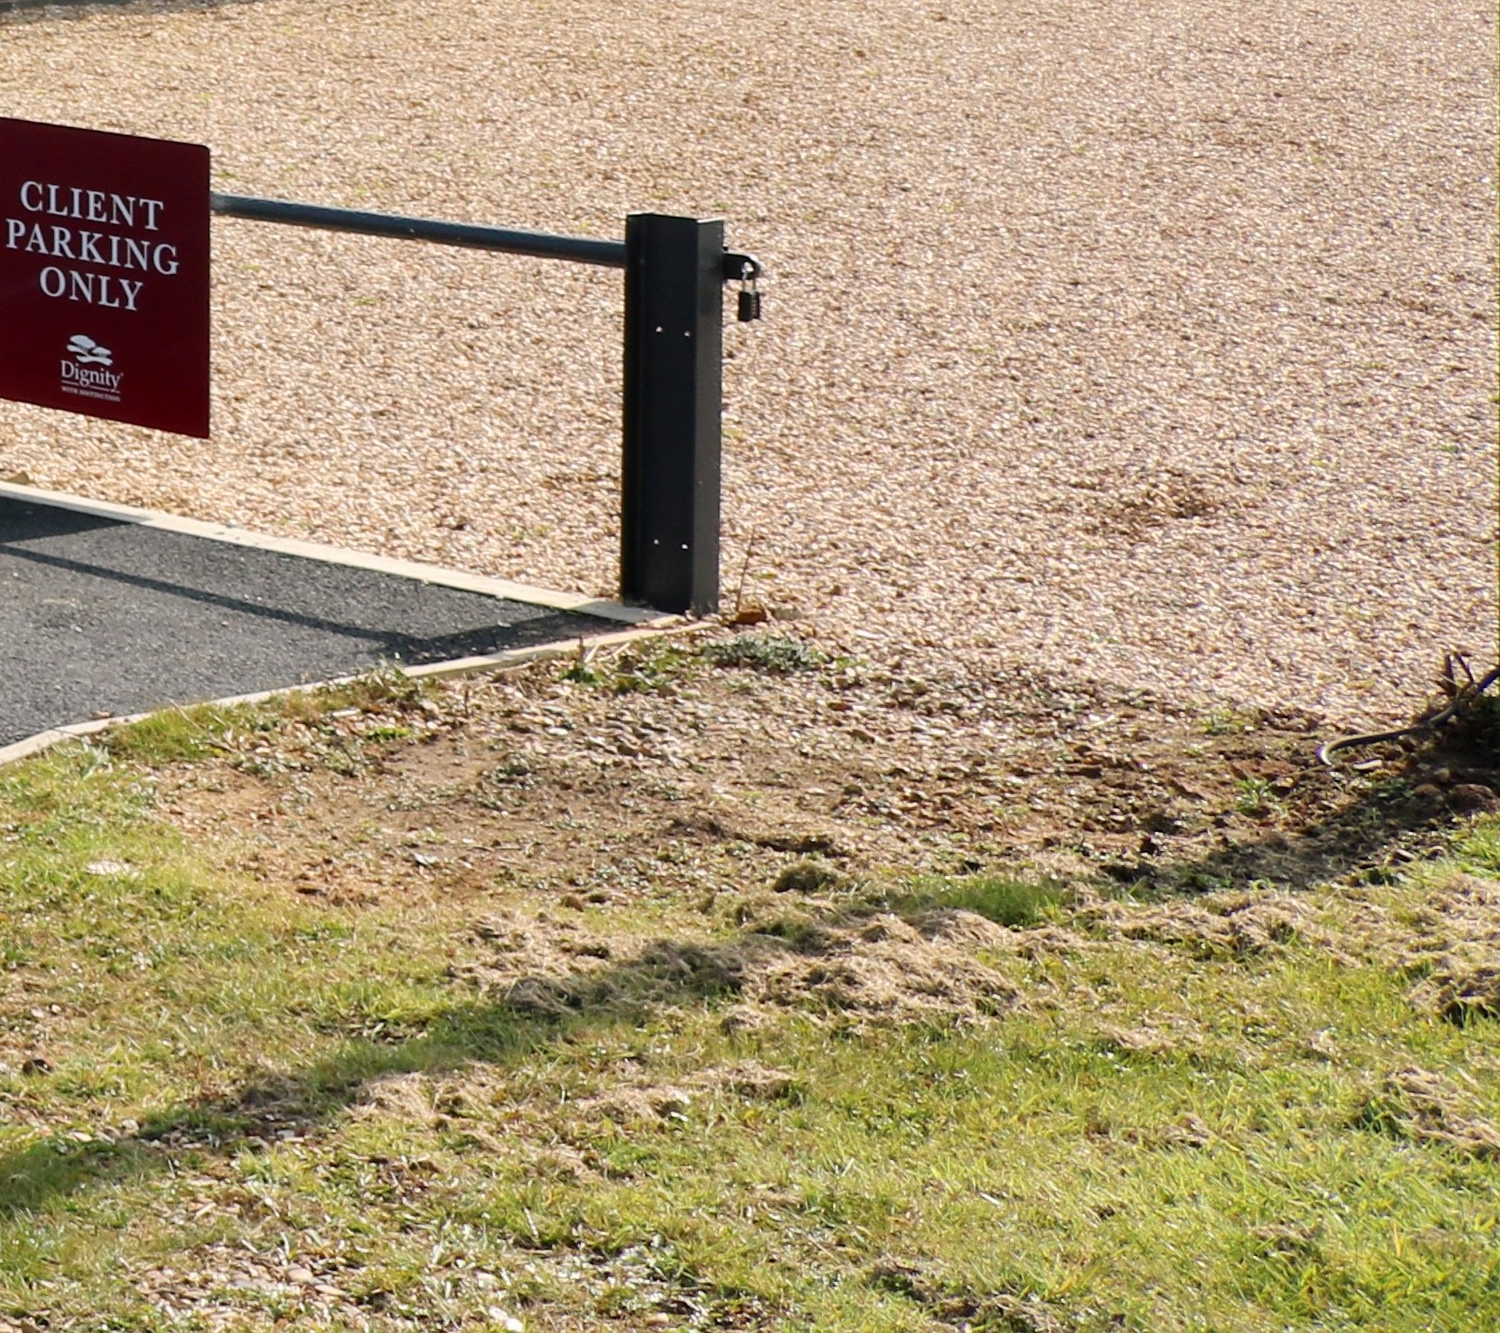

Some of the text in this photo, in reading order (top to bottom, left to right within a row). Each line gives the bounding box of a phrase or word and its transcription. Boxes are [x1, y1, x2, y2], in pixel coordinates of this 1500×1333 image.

[20, 180, 164, 231] CLIENT
[5, 218, 179, 275] PARKING
[39, 266, 143, 311] ONLY
[61, 360, 121, 392] Dignity
